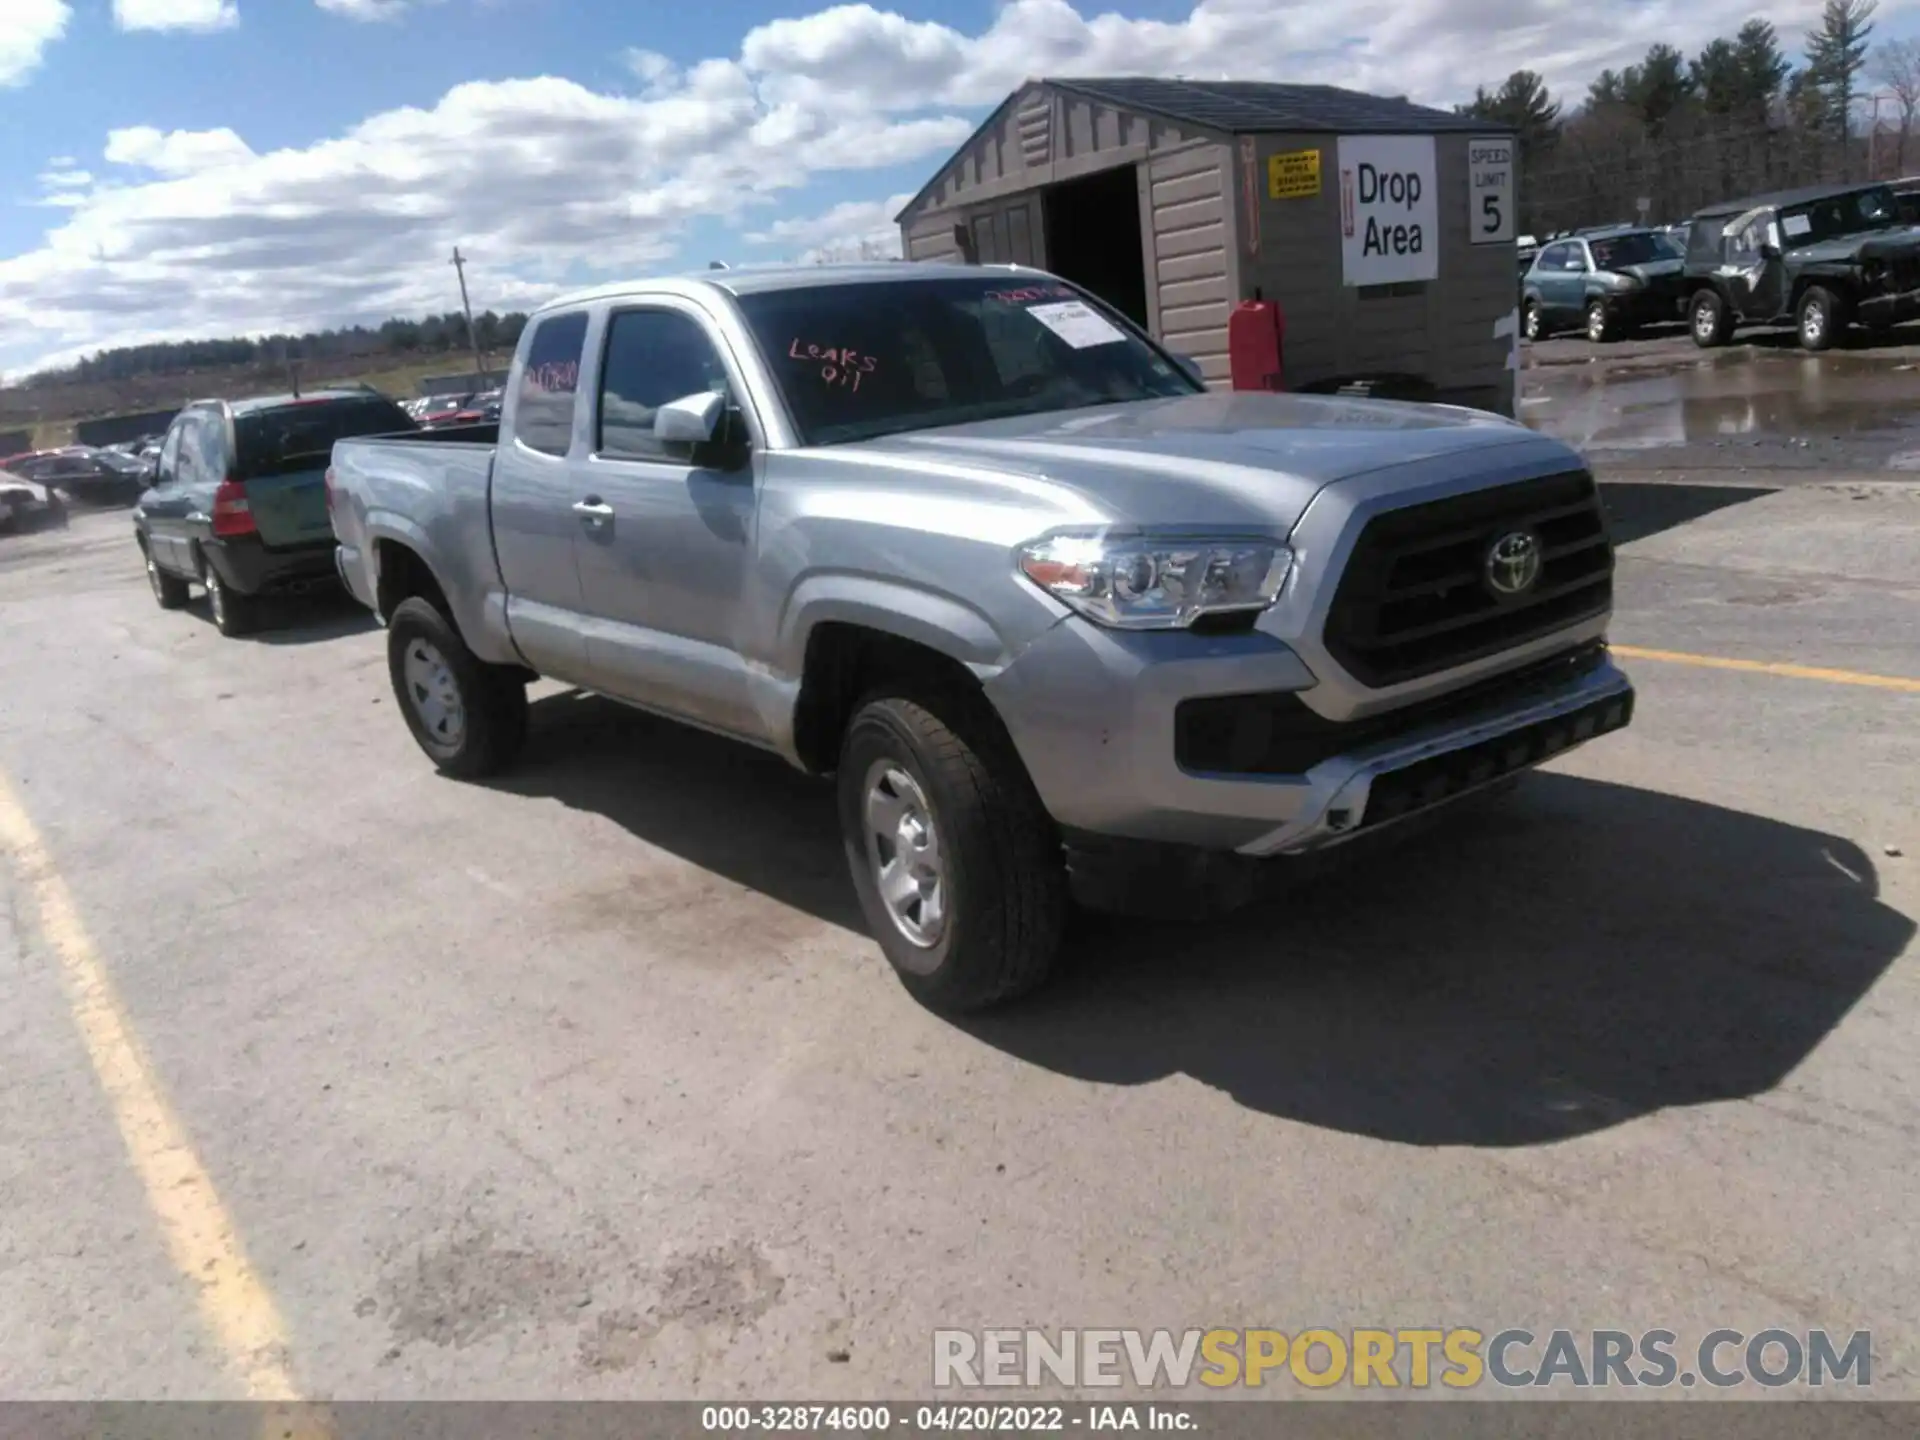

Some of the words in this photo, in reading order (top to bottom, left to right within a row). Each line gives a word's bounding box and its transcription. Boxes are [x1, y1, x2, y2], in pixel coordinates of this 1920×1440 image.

[1471, 148, 1511, 163] SPEED
[1358, 163, 1421, 210] Drop
[1475, 172, 1506, 187] LIMIT
[1483, 195, 1502, 233] 5
[1363, 216, 1422, 257] Area
